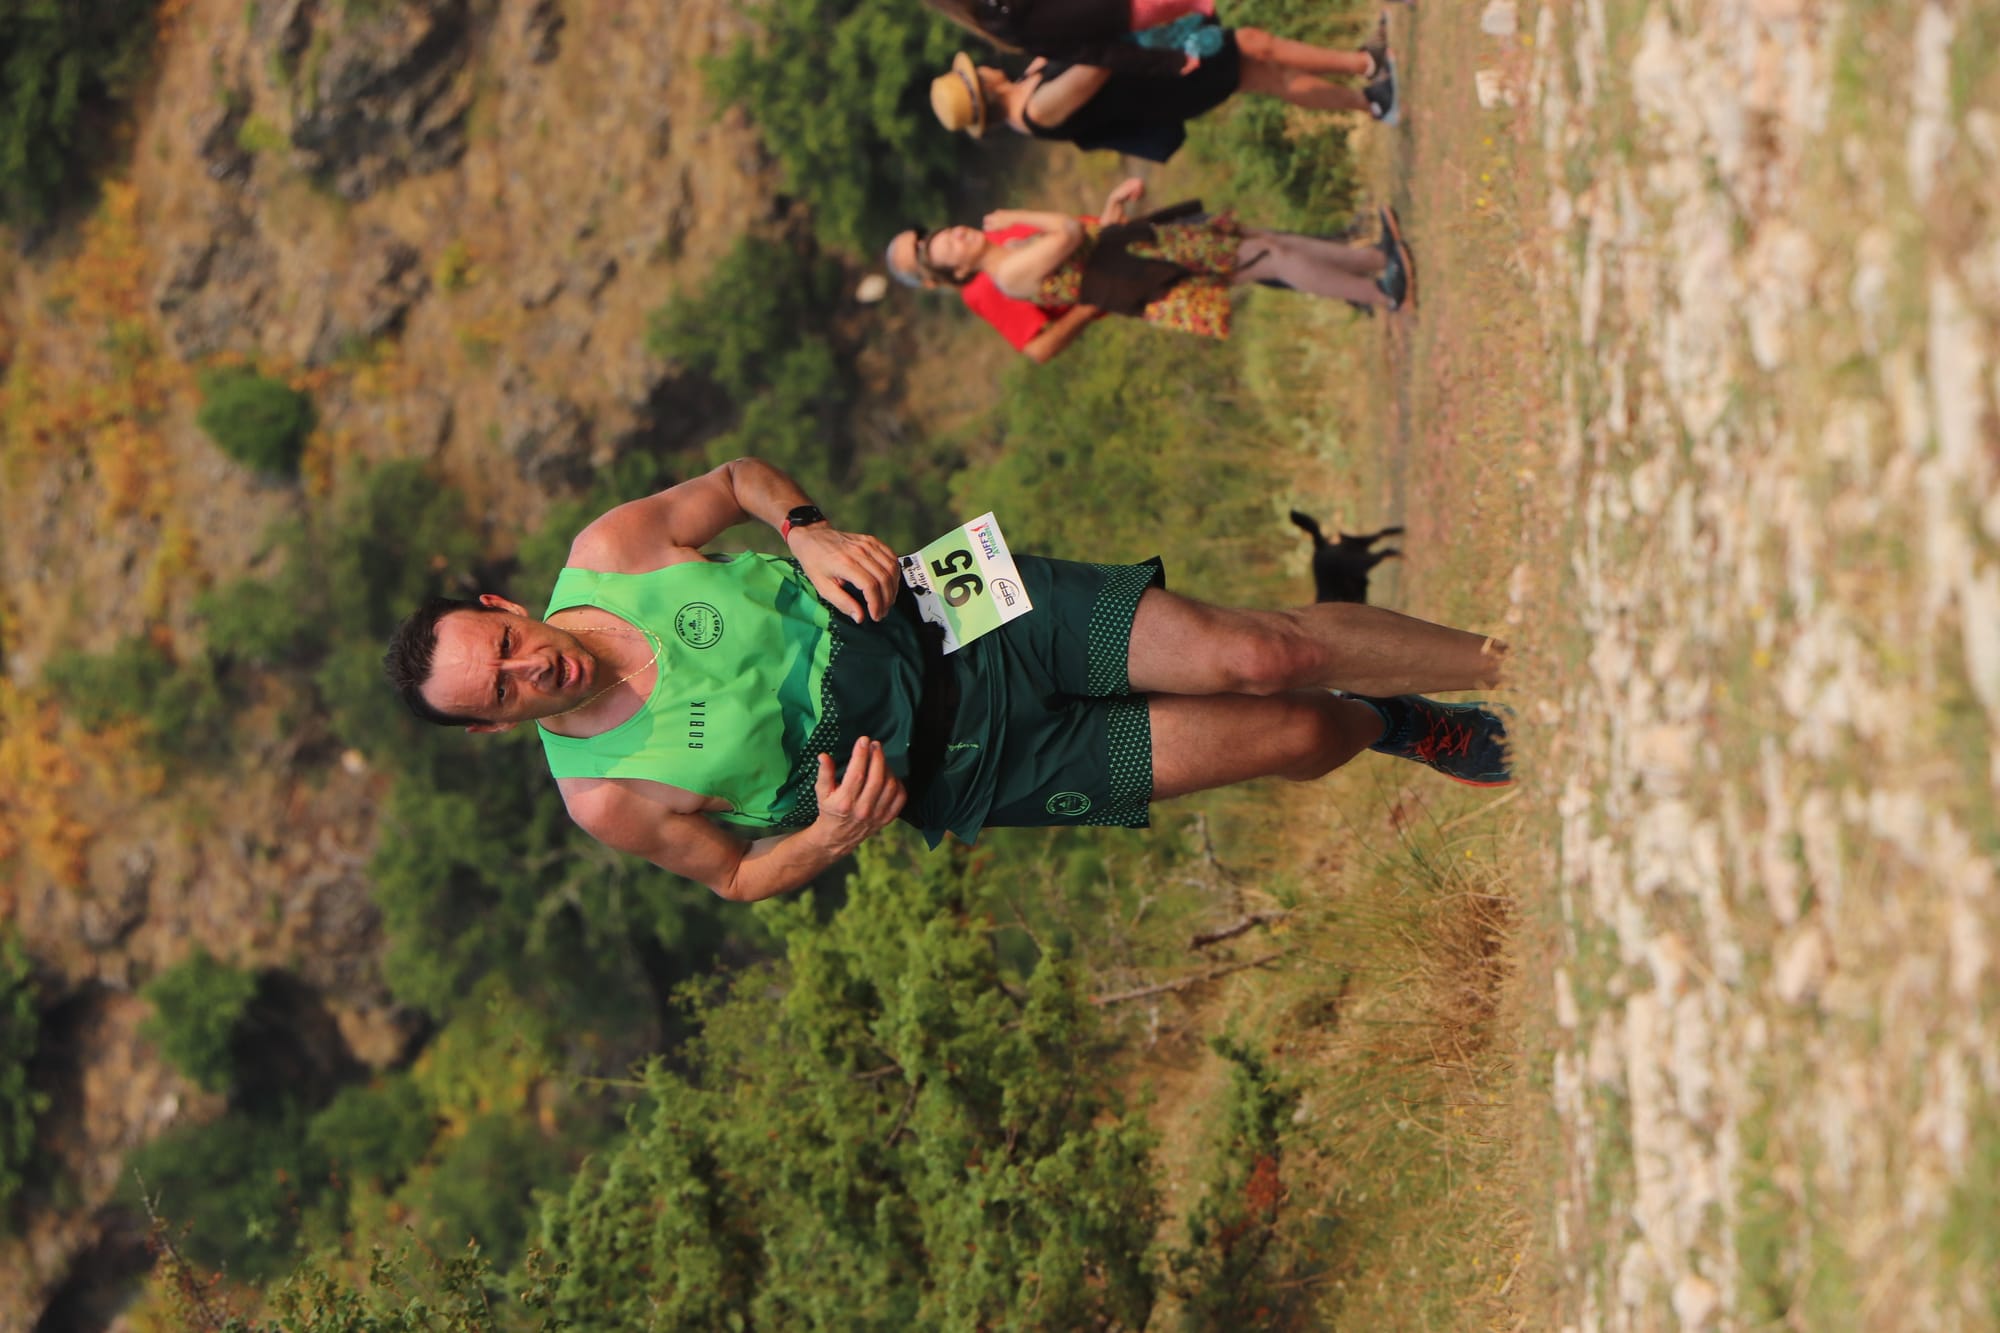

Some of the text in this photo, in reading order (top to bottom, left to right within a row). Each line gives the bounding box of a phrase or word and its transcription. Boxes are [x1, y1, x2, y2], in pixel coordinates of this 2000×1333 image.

[931, 549, 983, 607] 95
[999, 581, 1015, 606] BFP
[677, 614, 685, 637] SINCE
[712, 613, 720, 638] 1991
[688, 701, 706, 749] GOBIK
